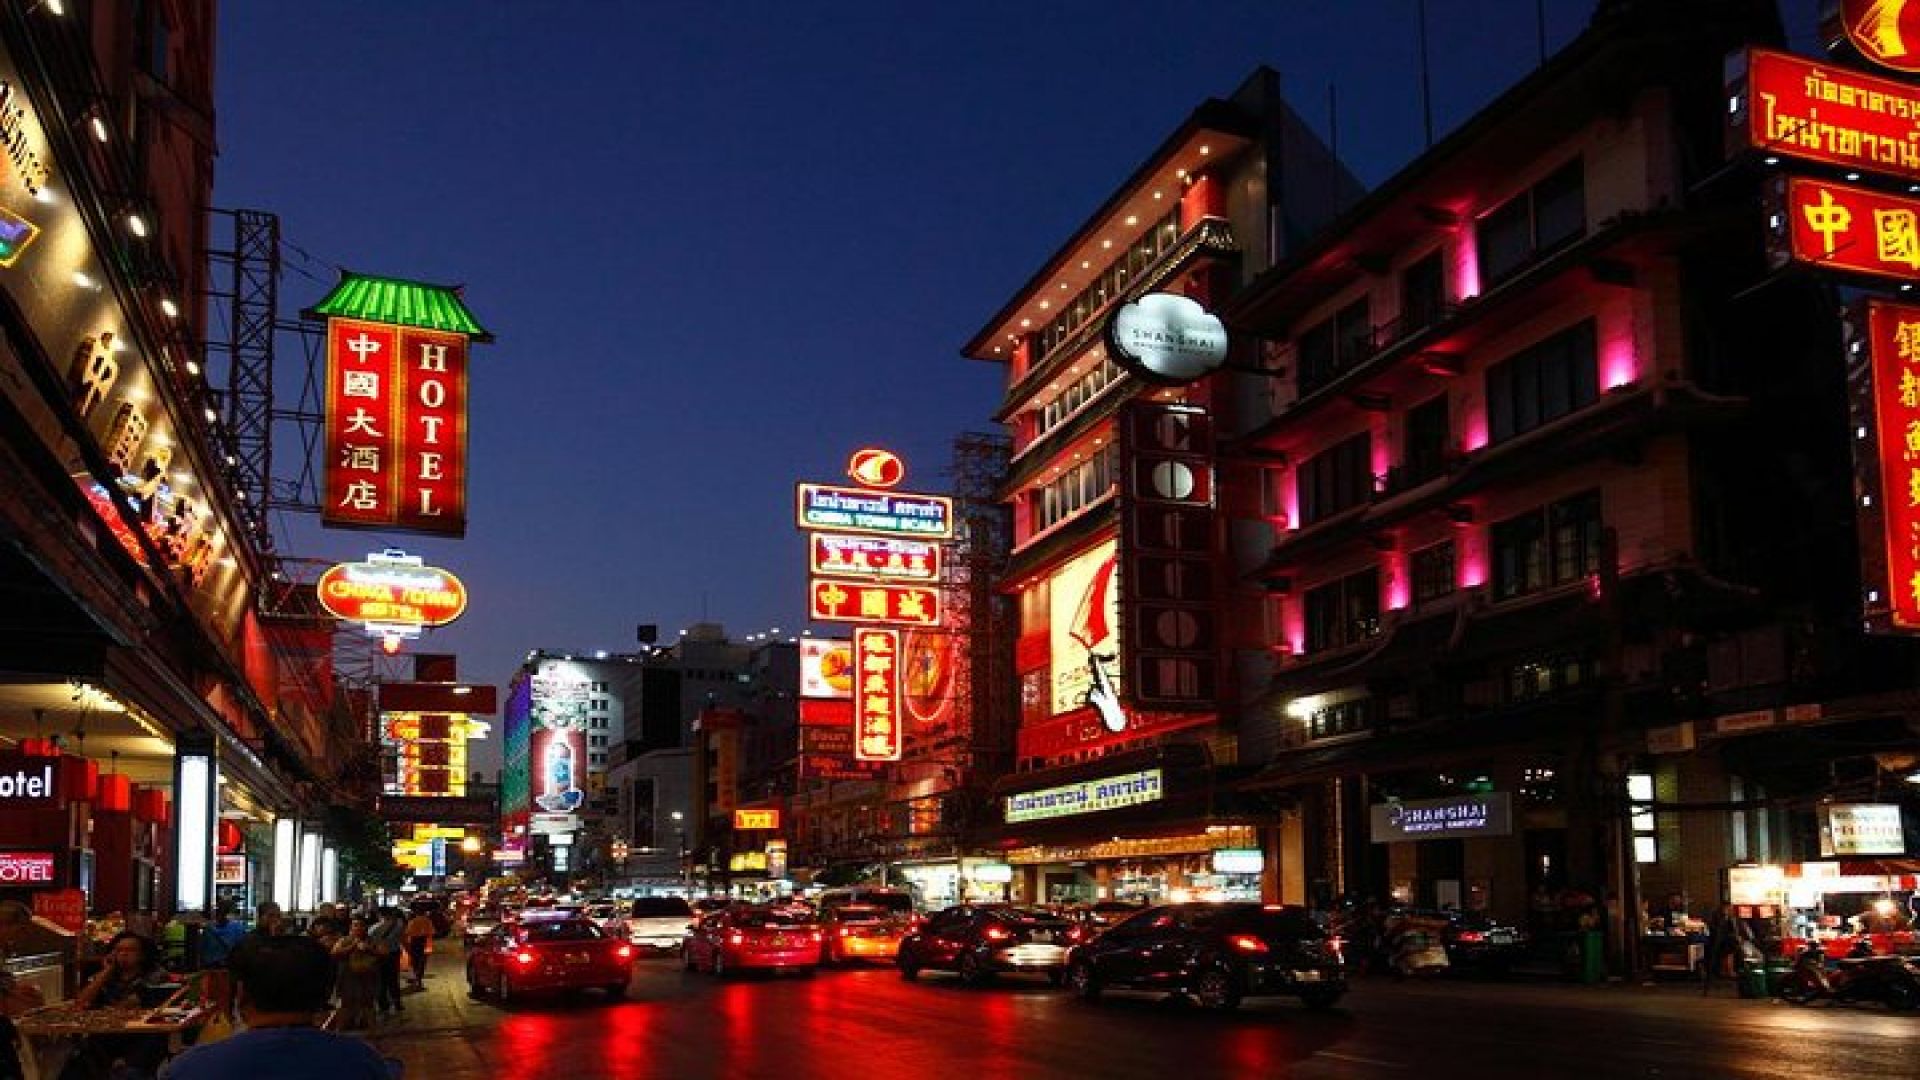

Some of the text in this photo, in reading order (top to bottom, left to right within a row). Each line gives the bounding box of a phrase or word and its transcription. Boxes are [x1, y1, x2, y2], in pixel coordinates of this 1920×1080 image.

[341, 332, 384, 510] 中國大酒店
[1132, 327, 1215, 348] SHANGHAI
[418, 343, 448, 517] HOTEL
